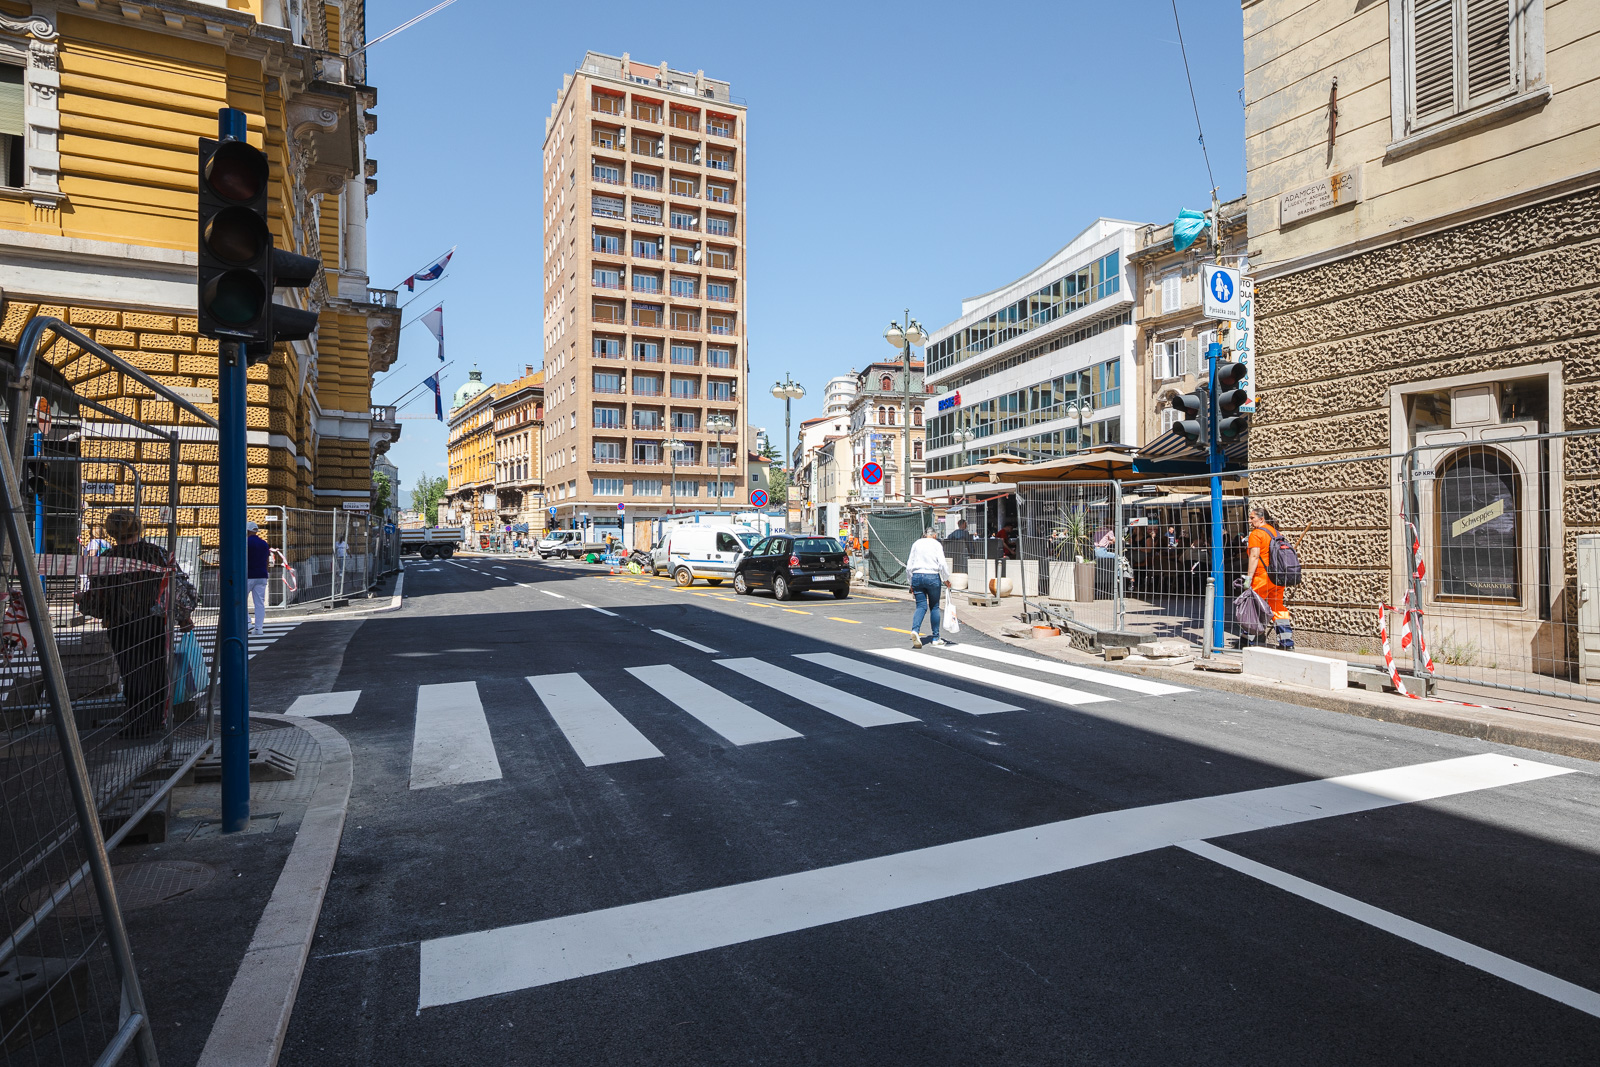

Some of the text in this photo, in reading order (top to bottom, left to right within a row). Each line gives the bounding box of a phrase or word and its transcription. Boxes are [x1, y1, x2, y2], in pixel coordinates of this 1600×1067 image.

[1330, 174, 1353, 187] ULICA
[1240, 290, 1253, 299] OLA
[1461, 508, 1494, 529] Schweppes
[1478, 582, 1512, 590] KARAKTER
